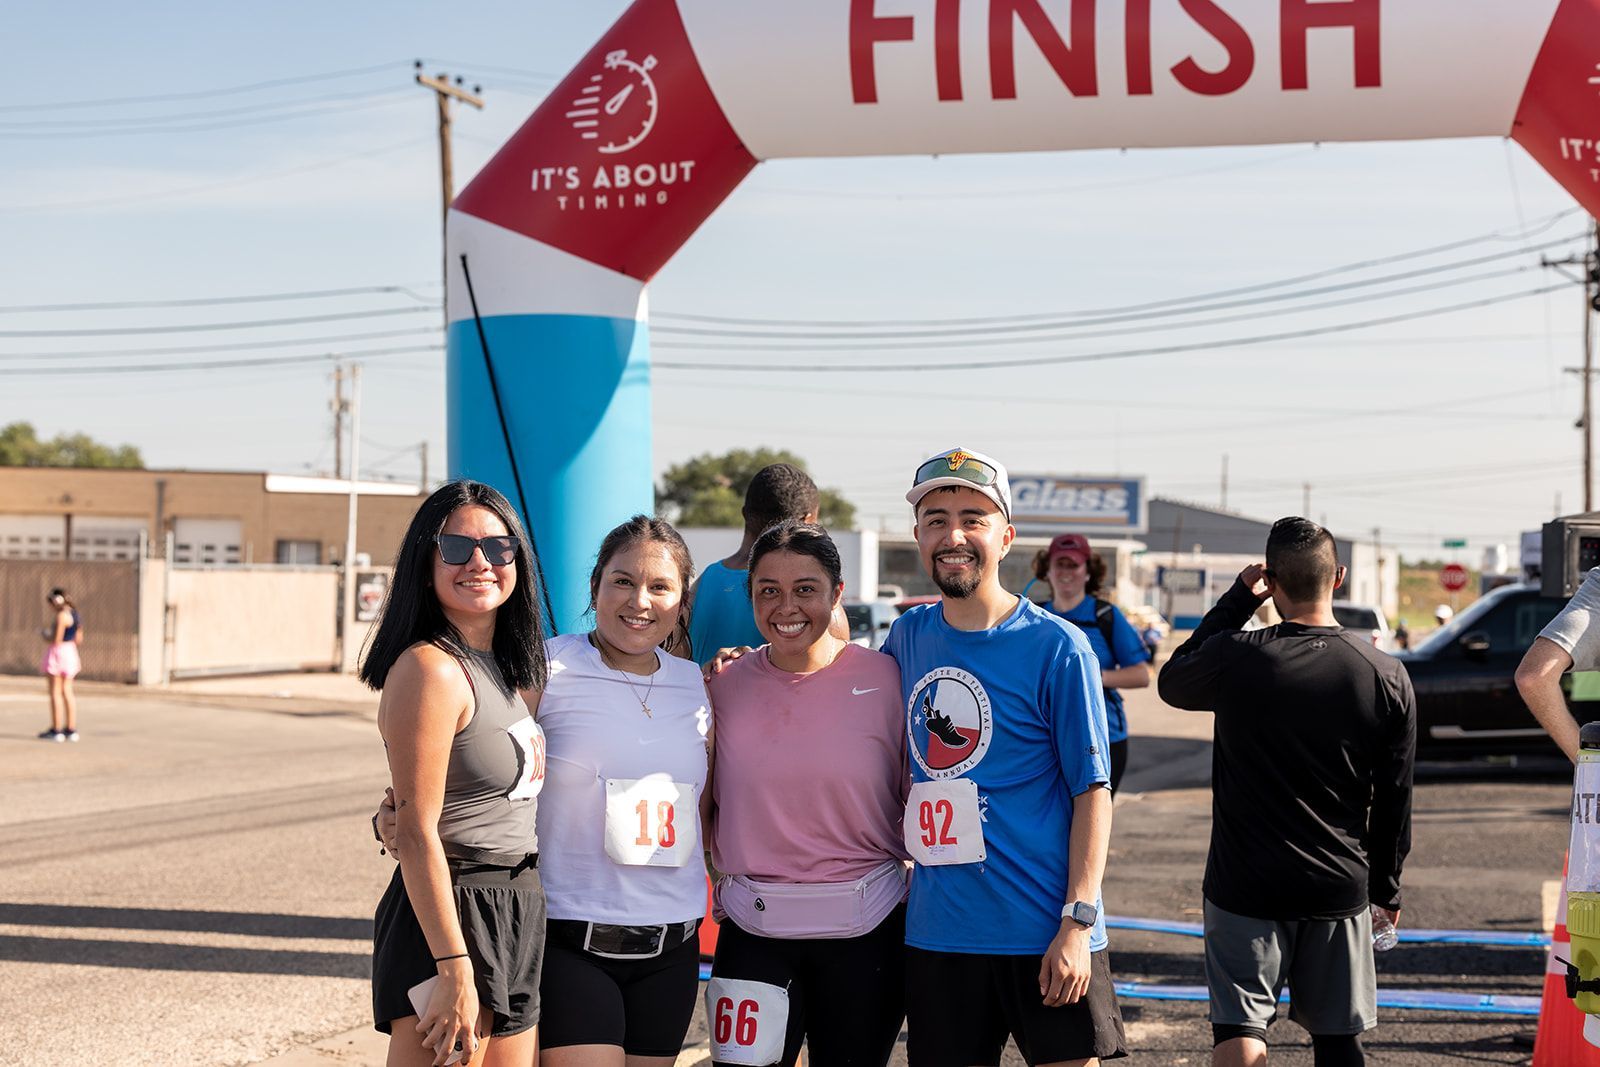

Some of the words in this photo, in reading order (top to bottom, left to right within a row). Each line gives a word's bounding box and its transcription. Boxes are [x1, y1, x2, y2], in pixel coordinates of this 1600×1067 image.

[849, 0, 1382, 104] FINISH
[531, 166, 580, 192] IT'S
[592, 160, 696, 189] ABOUT
[557, 190, 669, 211] TIMING
[1011, 480, 1130, 511] Glass
[635, 799, 676, 848] 18
[919, 799, 958, 848] 92
[714, 996, 760, 1047] 66
